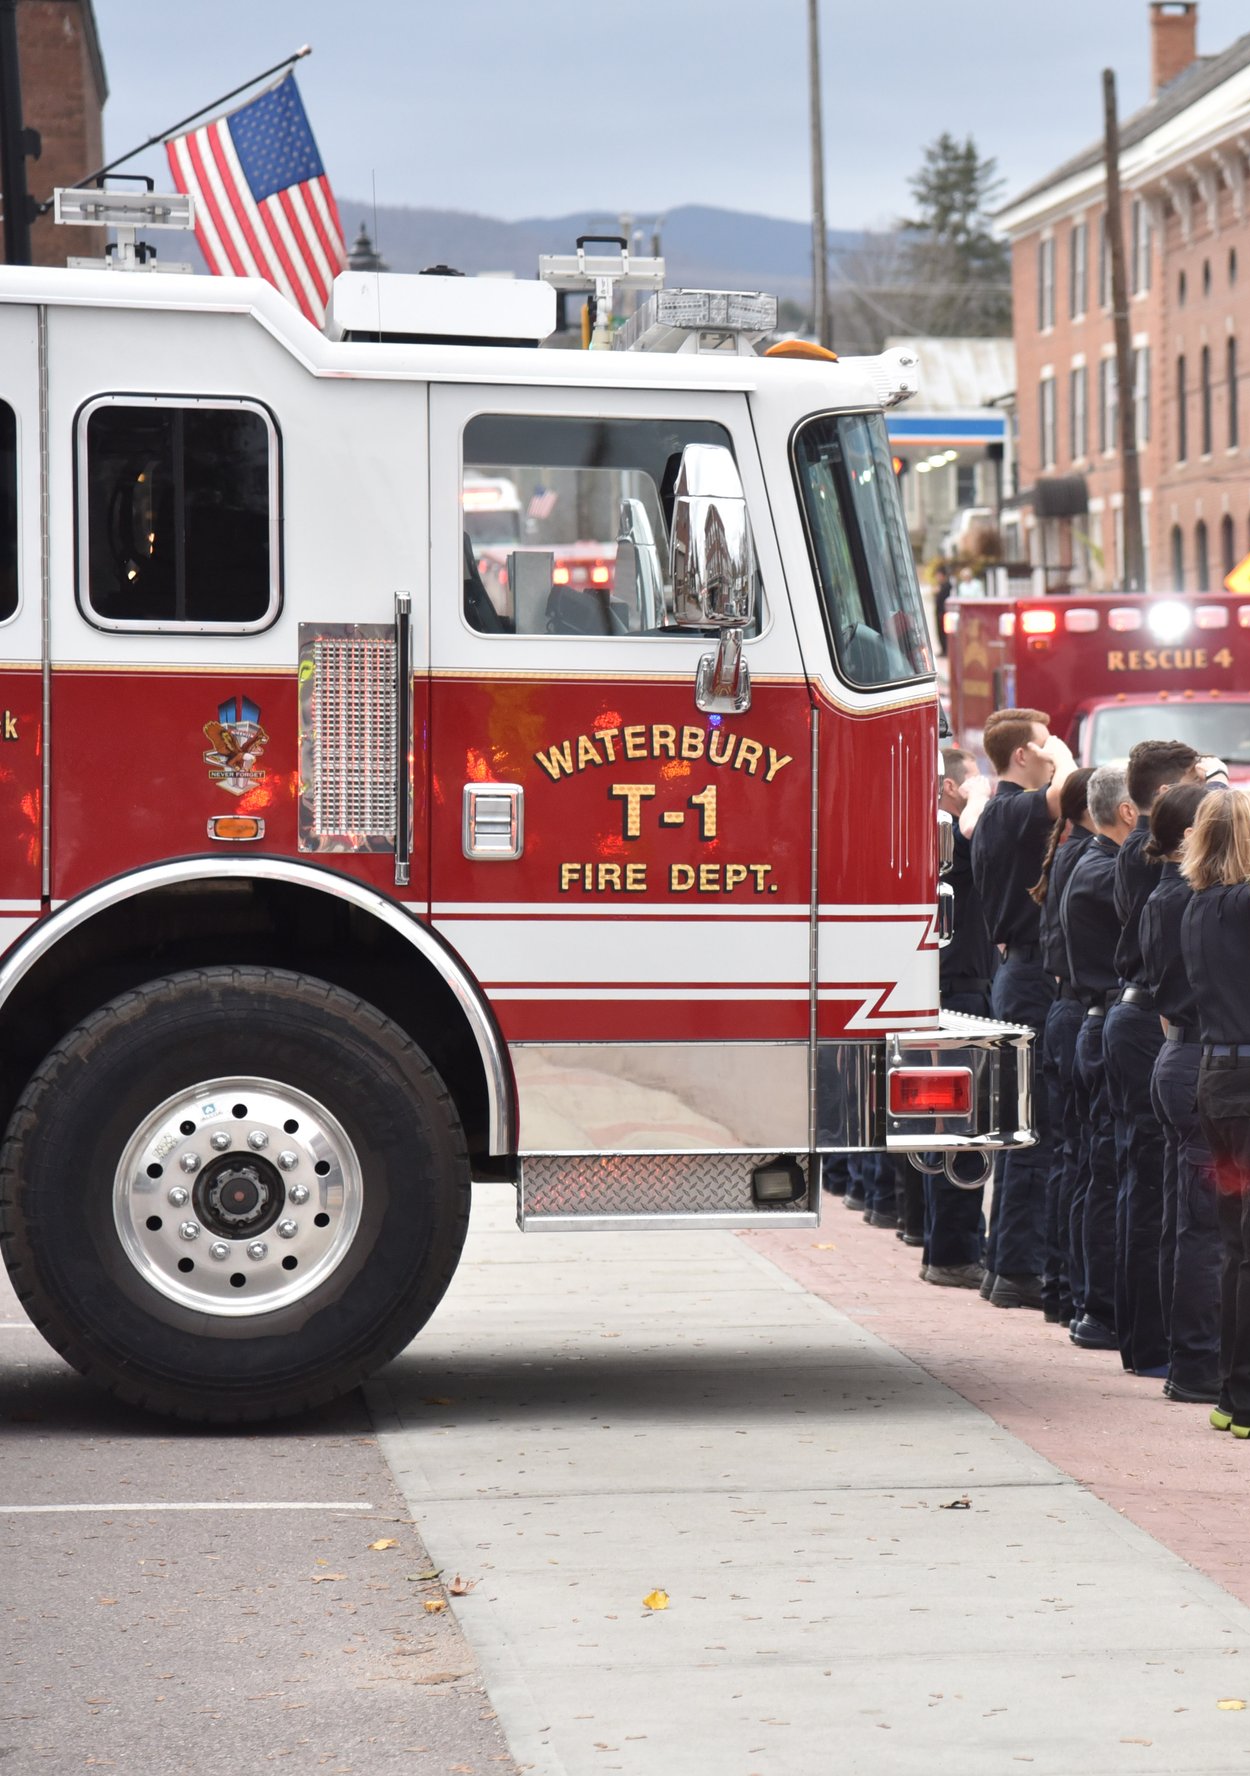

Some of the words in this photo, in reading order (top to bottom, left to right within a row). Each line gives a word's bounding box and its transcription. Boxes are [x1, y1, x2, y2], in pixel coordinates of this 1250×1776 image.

[1107, 648, 1208, 671] RESCUE
[1213, 648, 1234, 669] 4
[533, 724, 793, 784] WATERBURY
[611, 784, 717, 838] T-1
[560, 863, 648, 891] FIRE
[670, 863, 778, 892] DEPT.
